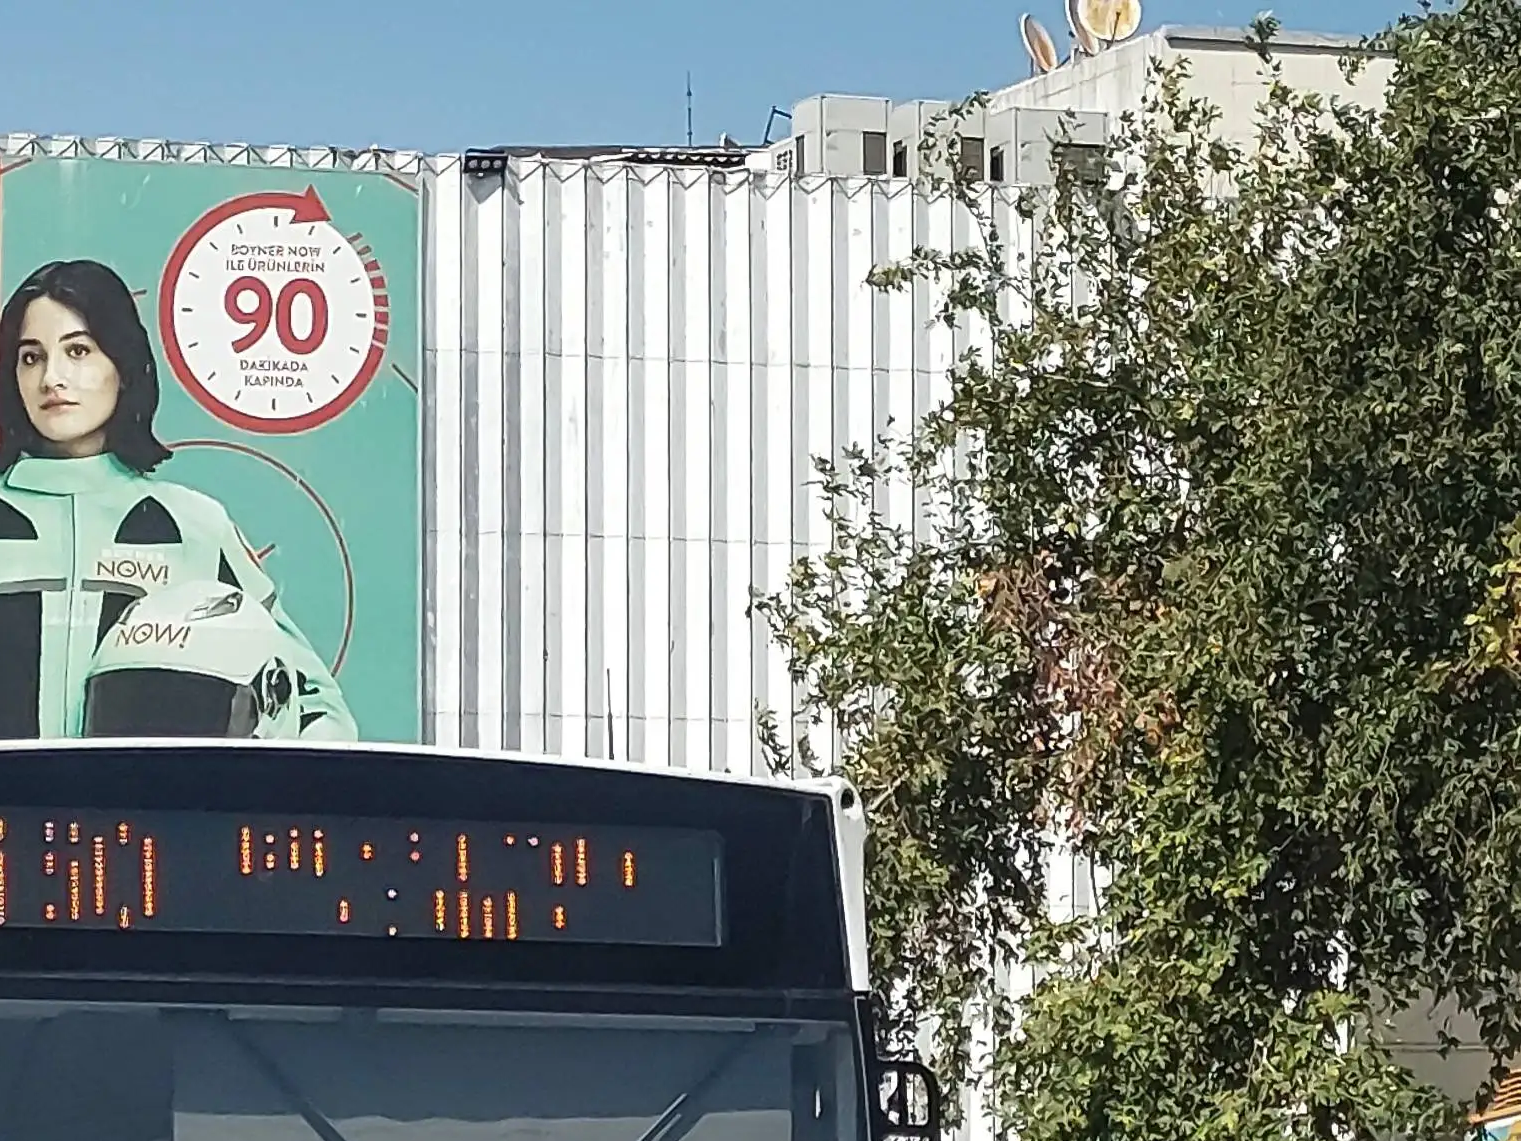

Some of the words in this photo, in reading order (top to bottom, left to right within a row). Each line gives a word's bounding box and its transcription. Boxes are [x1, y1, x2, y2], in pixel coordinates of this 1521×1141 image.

[288, 245, 322, 257] NOW
[224, 275, 328, 355] 90
[244, 374, 304, 388] KAPINDA
[96, 560, 169, 586] NOW!
[115, 622, 191, 649] NOW!
